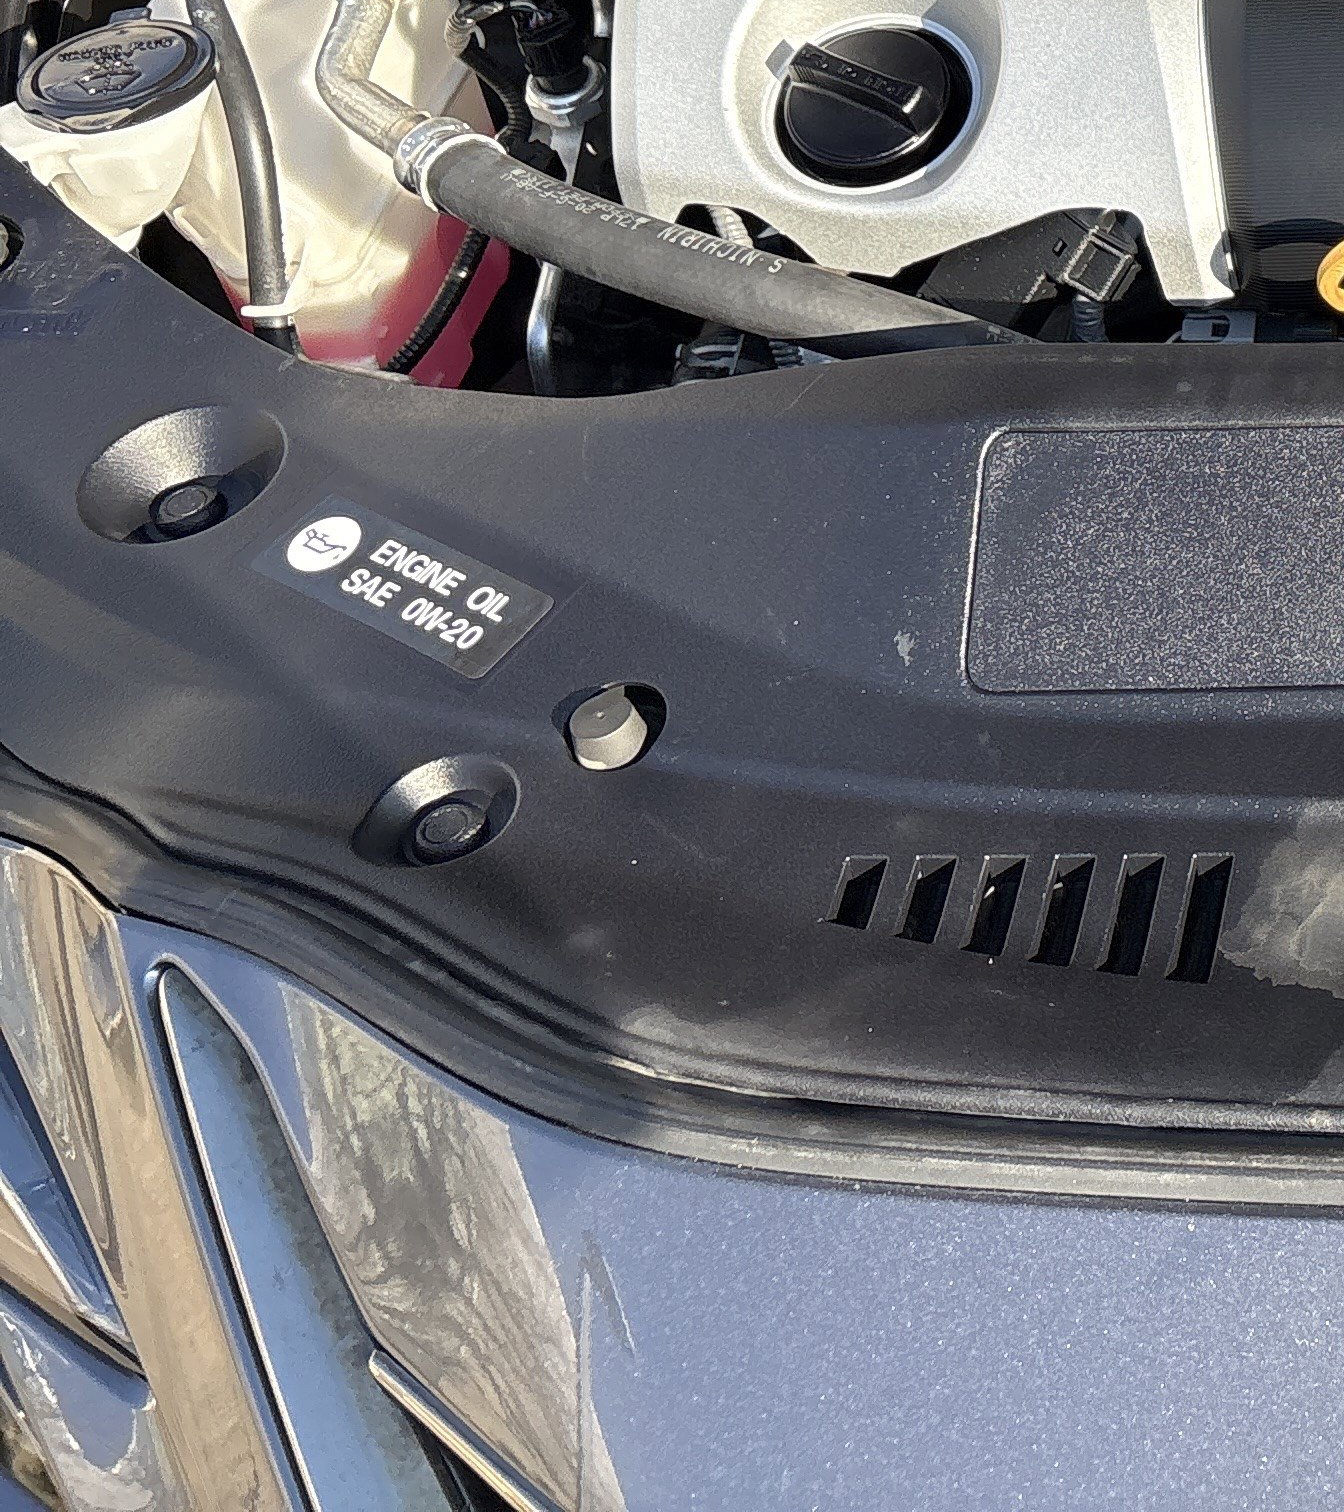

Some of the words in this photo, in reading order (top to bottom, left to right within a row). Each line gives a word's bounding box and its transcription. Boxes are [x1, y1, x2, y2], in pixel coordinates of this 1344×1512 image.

[656, 224, 761, 266] NICHIRIN
[340, 568, 401, 607] SAE
[401, 597, 484, 650] 0W-20
[370, 539, 467, 596] ENGINE
[466, 586, 511, 623] OIL
